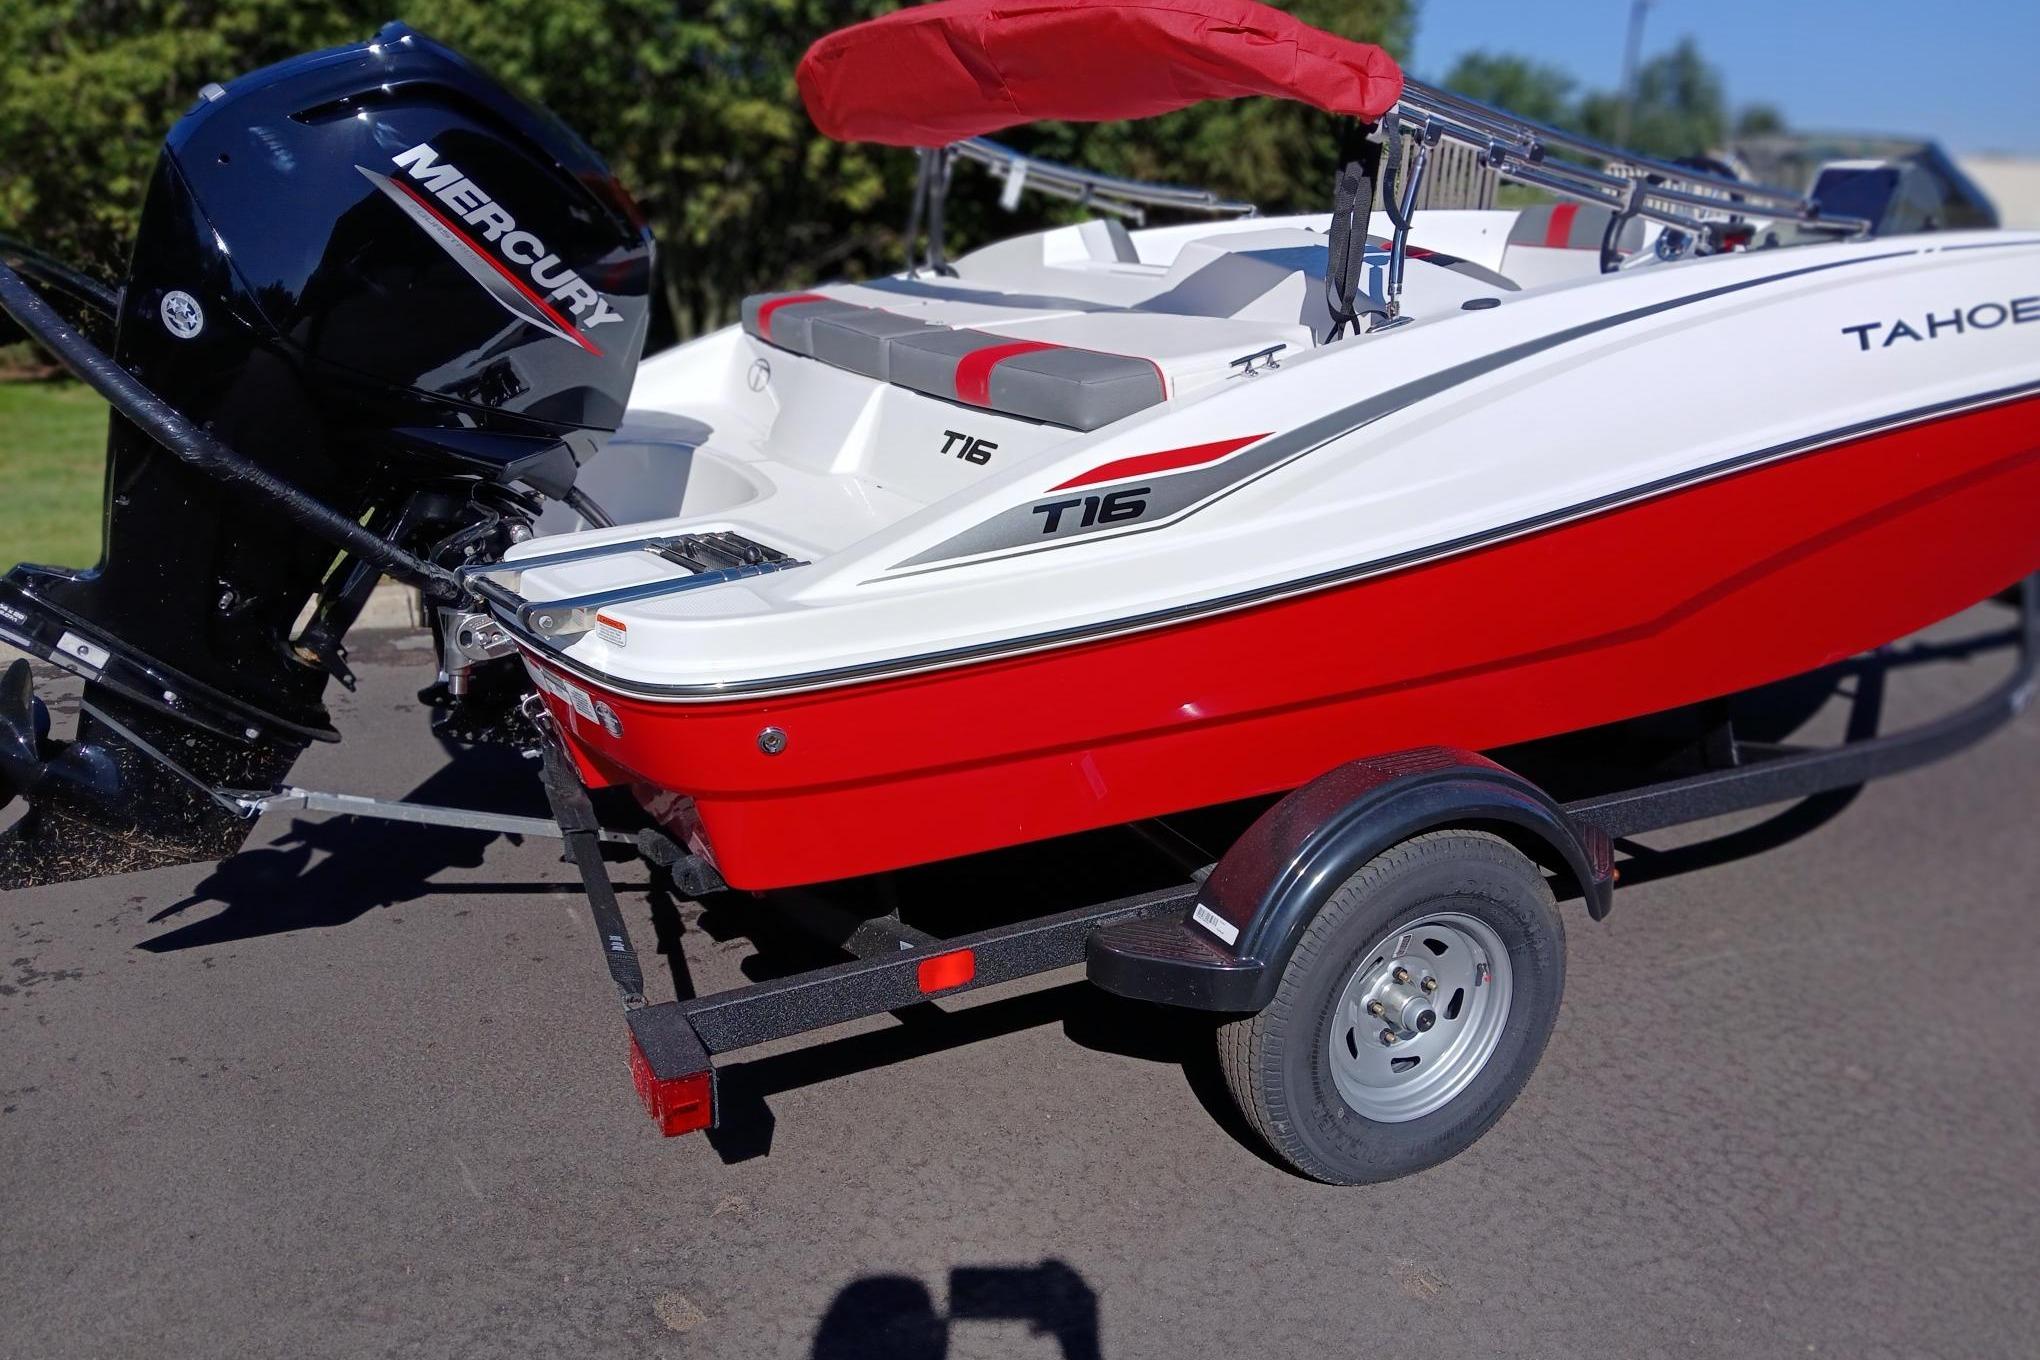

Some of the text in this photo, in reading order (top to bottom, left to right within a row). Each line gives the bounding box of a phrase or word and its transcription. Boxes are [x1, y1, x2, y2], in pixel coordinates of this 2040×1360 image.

[391, 142, 625, 329] MERCURY
[1841, 296, 2040, 351] TAHOE
[940, 429, 998, 466] T16
[1032, 486, 1151, 534] T16
